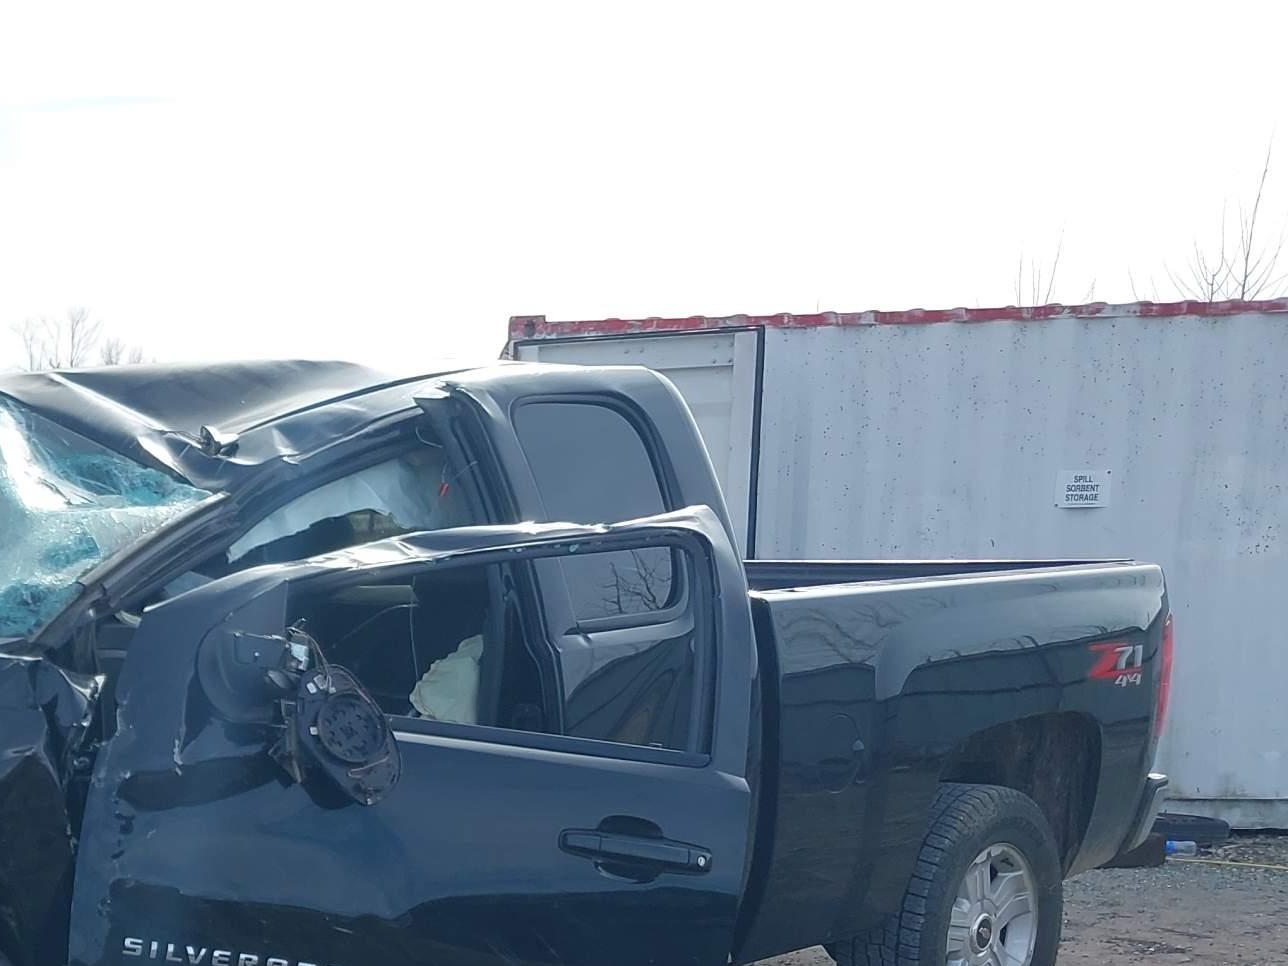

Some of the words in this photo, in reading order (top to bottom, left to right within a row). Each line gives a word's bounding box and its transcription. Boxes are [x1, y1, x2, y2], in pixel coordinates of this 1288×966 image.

[1073, 475, 1093, 483] SPILL
[1065, 484, 1100, 492] SORBENT
[1065, 493, 1099, 502] STORAGE
[1087, 640, 1144, 679] Z71
